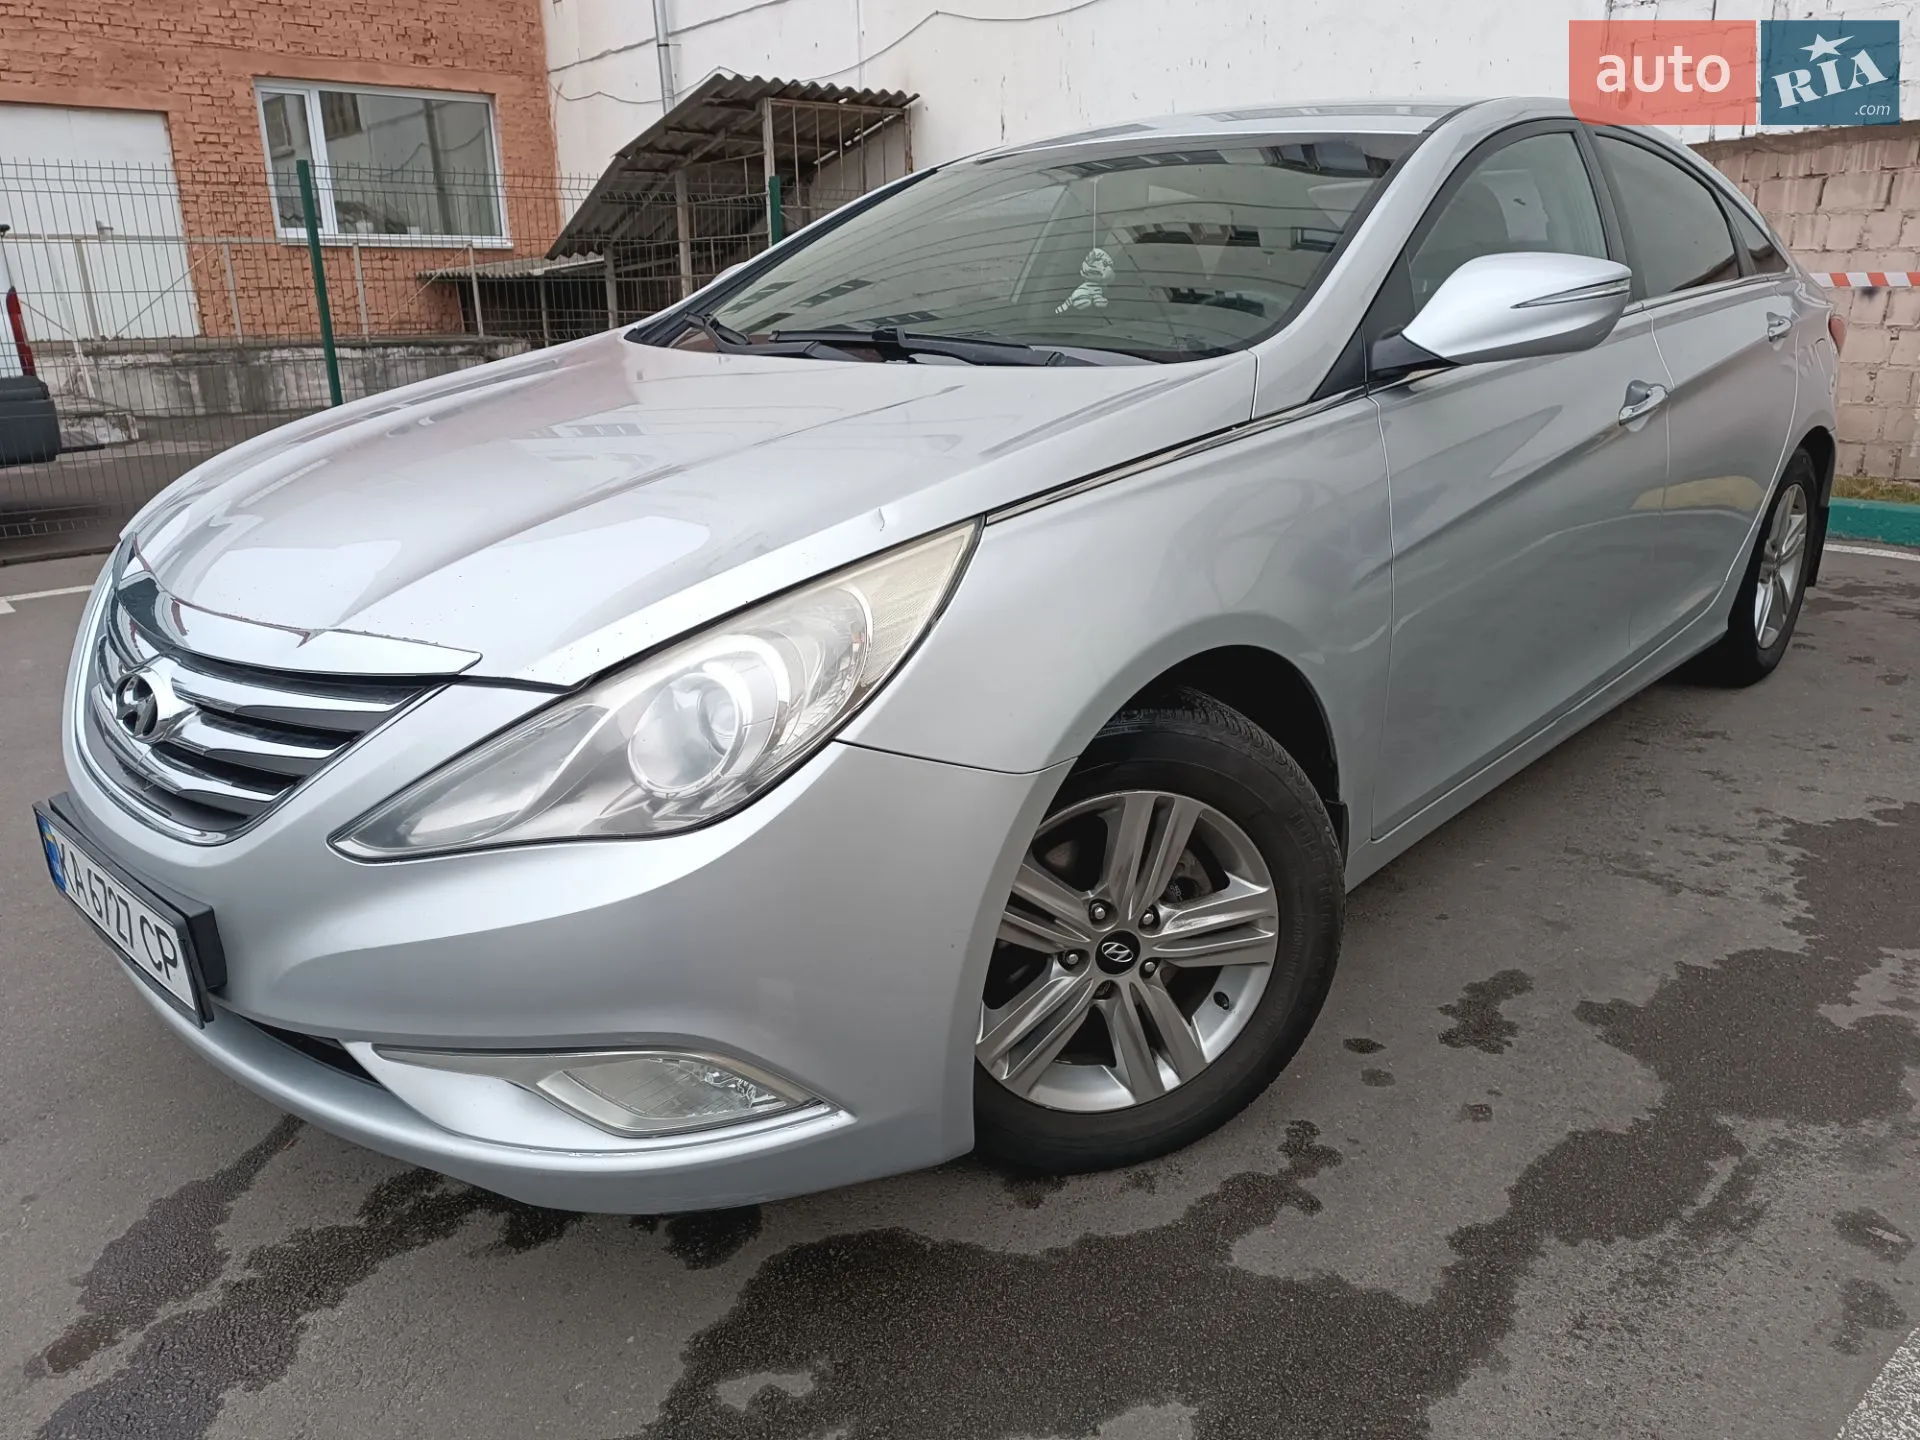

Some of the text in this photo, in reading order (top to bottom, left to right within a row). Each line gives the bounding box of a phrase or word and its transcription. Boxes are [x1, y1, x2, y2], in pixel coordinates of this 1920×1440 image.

[55, 840, 178, 981] KA 6727 CP
